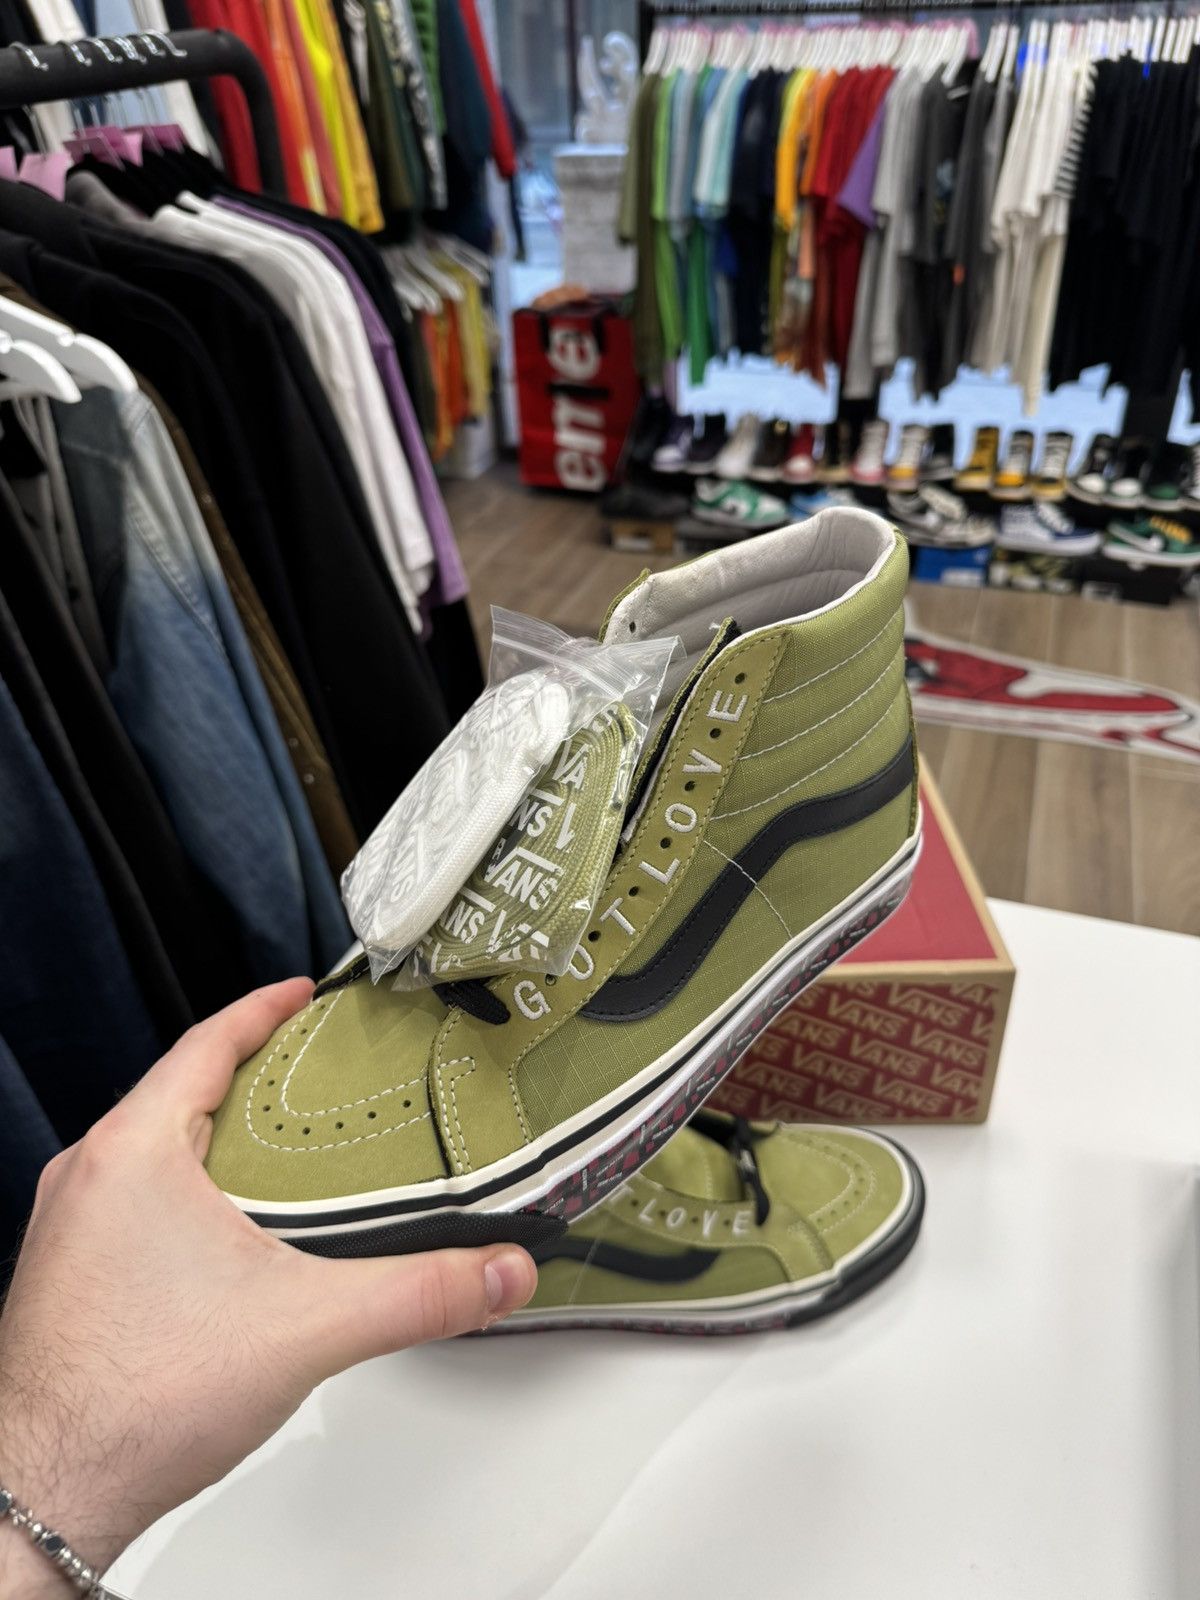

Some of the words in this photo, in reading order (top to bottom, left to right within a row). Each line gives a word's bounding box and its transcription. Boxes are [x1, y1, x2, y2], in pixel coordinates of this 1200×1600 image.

[484, 838, 564, 912] VANS
[887, 982, 970, 1028] VANS
[828, 991, 908, 1037] VANS
[911, 1021, 988, 1069] VANS
[792, 1043, 871, 1088] VANS
[872, 1072, 952, 1113] VANS
[851, 1032, 930, 1078] VANS
[734, 1060, 813, 1098] VANS
[638, 1199, 752, 1239] LOVE
